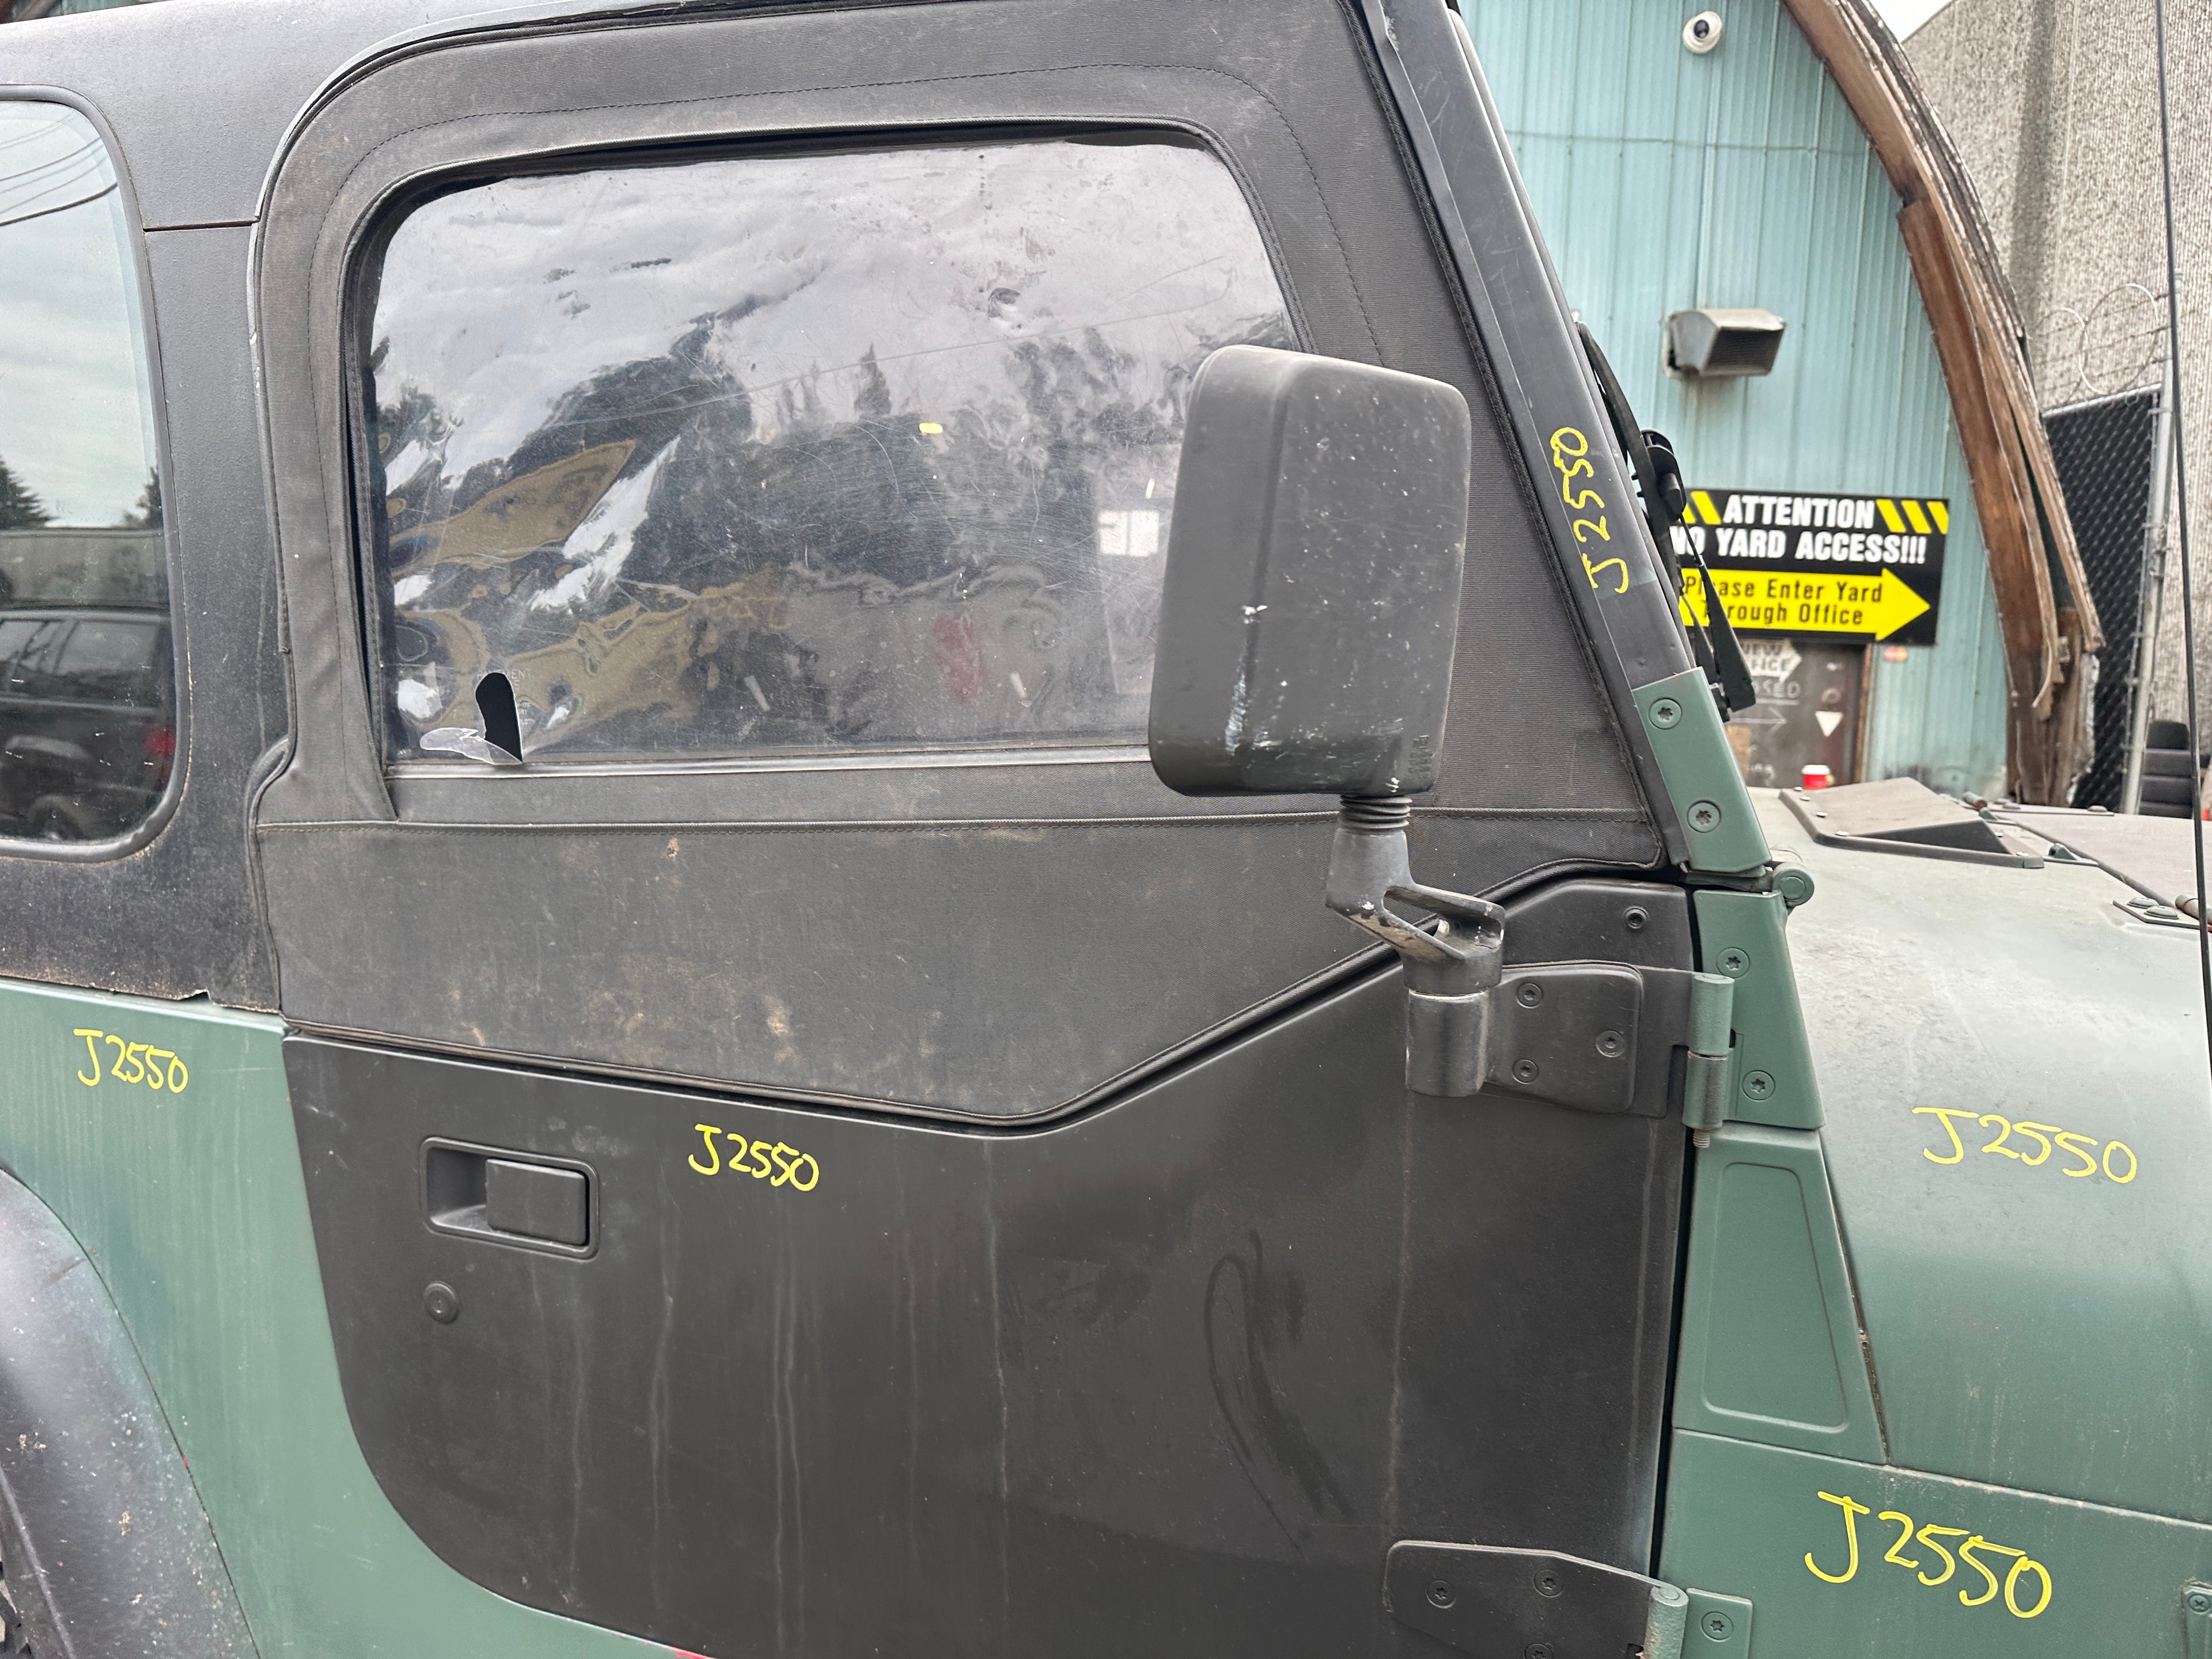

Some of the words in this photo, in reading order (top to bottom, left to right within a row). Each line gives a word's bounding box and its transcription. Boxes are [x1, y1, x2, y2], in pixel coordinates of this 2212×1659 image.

[1550, 427, 1629, 594] J2550
[1724, 494, 1874, 529] ATTENTION
[1669, 525, 1706, 555] NO
[1715, 527, 1786, 558] YARD
[1795, 531, 1927, 564] ACCESS!!!
[1685, 576, 1755, 596] Plase
[1767, 579, 1824, 600] Enter
[1836, 582, 1882, 602] Yard
[1700, 600, 1787, 624] Trough
[1799, 603, 1863, 624] Office
[73, 1028, 189, 1093] J2550
[688, 1123, 819, 1191] J2550
[1913, 1107, 2137, 1183] J2550
[1804, 1491, 2052, 1618] J2550
